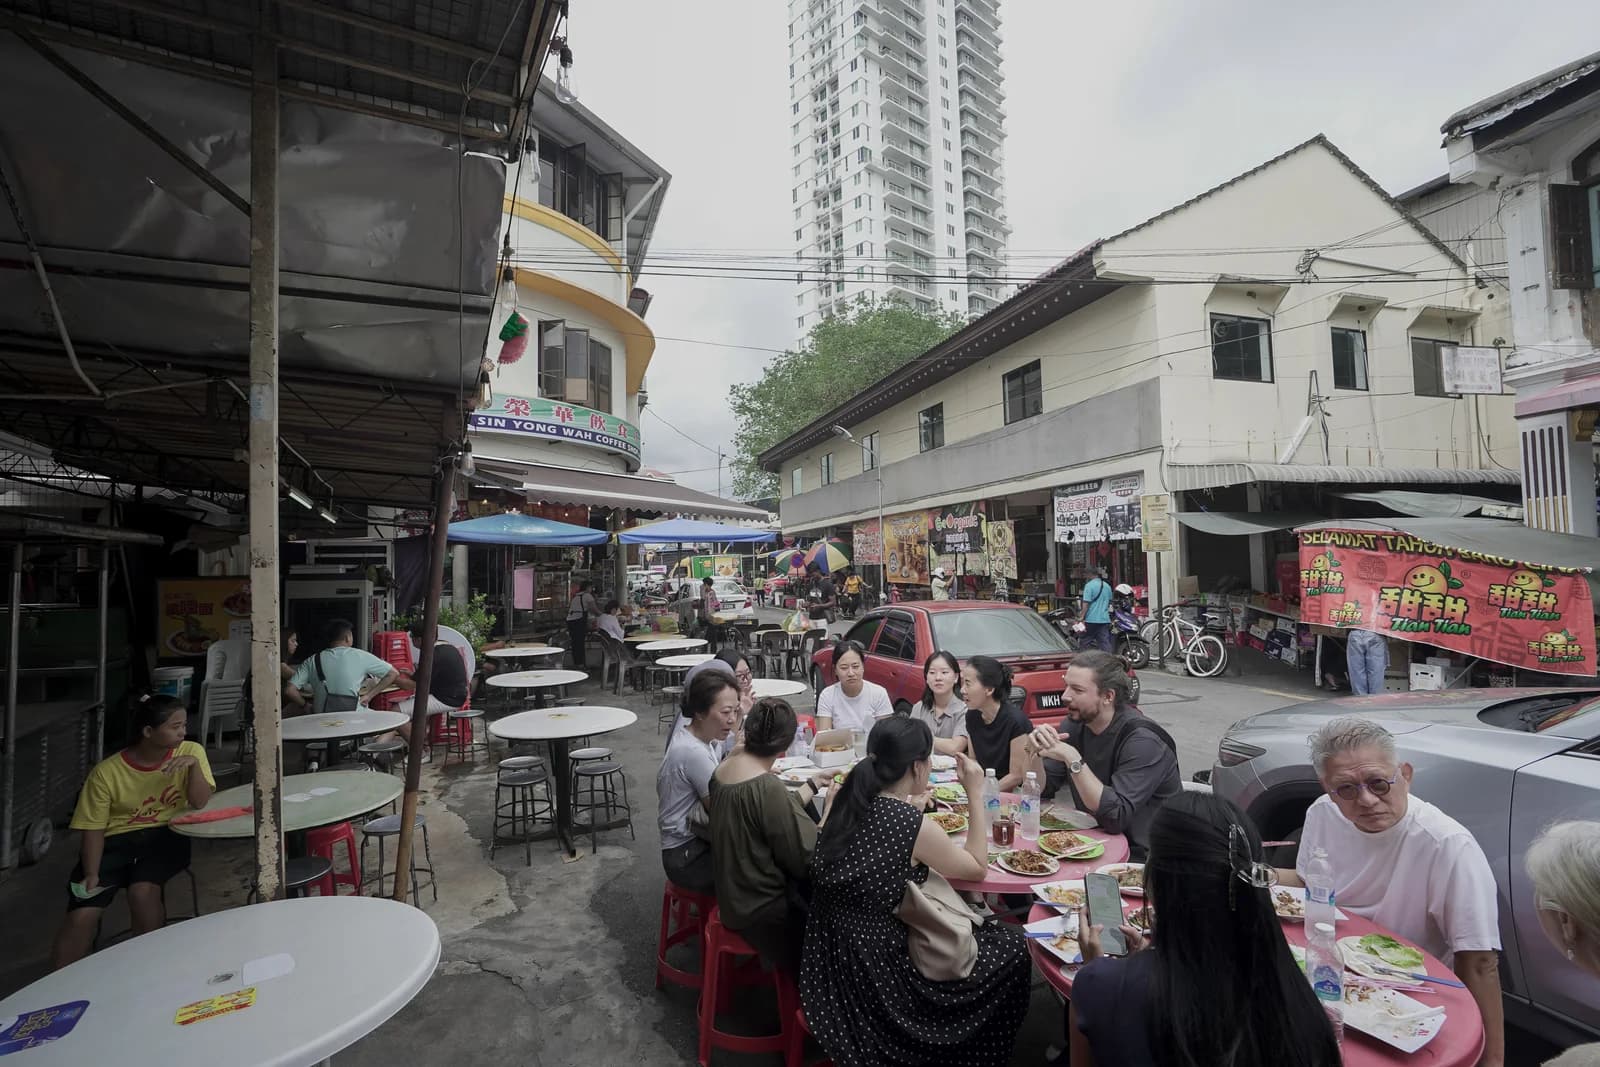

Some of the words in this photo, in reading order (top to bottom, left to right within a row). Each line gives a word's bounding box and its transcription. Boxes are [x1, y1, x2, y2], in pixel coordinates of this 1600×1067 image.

[477, 416, 506, 428] SIN
[512, 420, 557, 434] YONG
[562, 427, 592, 441] WAH
[595, 434, 627, 450] COFFEE
[1303, 532, 1377, 549] SELAMAT
[1378, 587, 1469, 624] 甜甜
[1489, 584, 1558, 612] 甜甜
[1500, 607, 1527, 619] Tian
[1529, 609, 1561, 621] Tian
[1391, 617, 1431, 632] Tian
[1434, 618, 1472, 634] Tian
[1041, 695, 1061, 708] WKH
